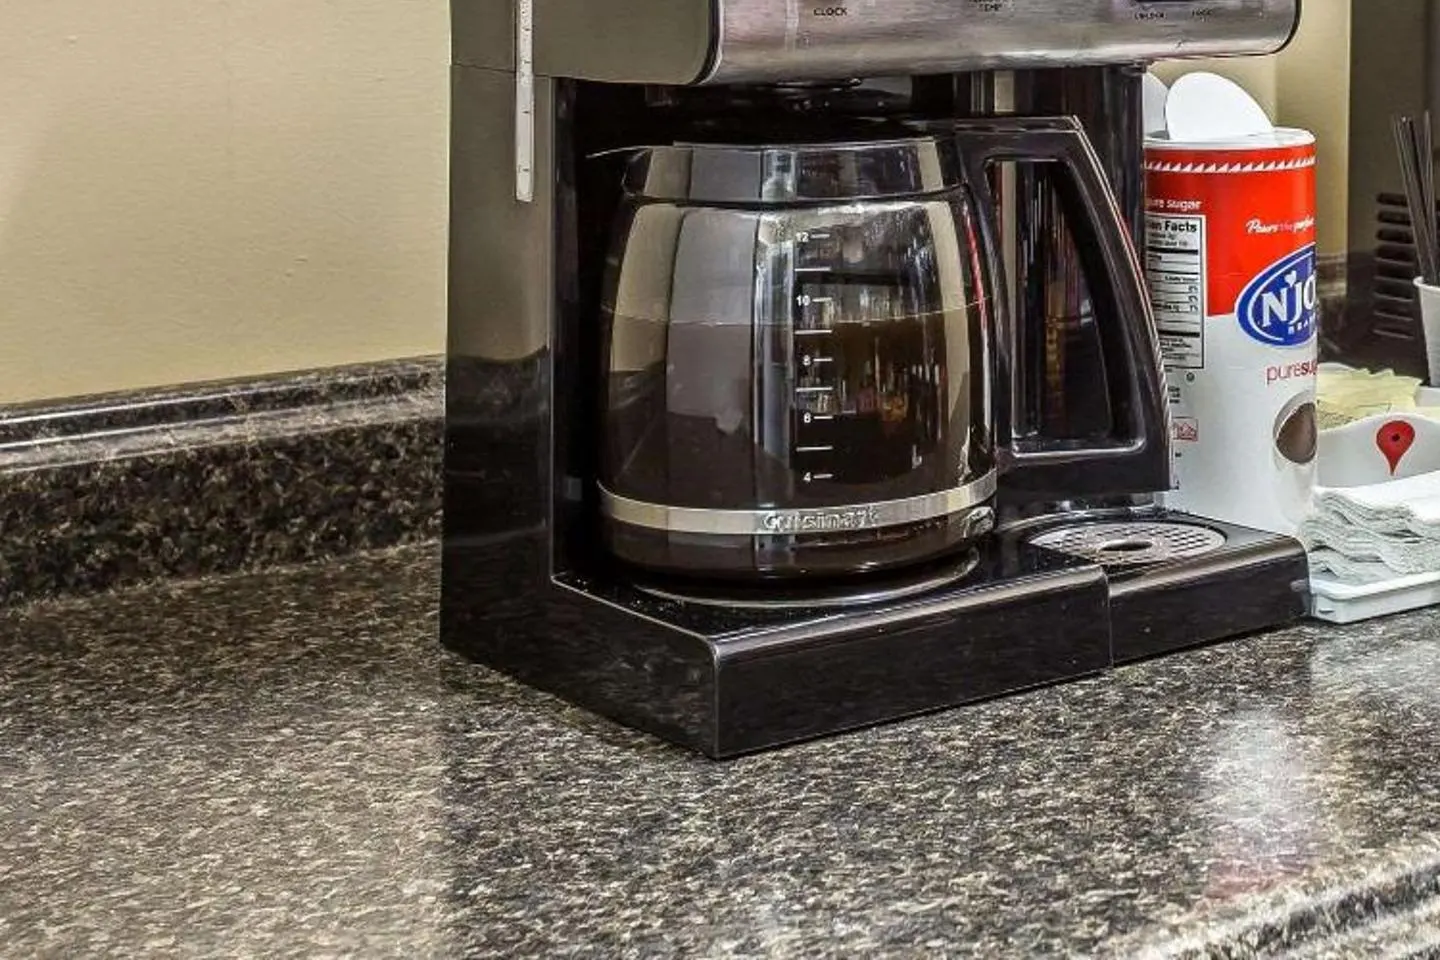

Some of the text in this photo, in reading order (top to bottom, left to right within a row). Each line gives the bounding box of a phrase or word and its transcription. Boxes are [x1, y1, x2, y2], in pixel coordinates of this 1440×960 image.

[813, 7, 848, 16] CLOCK
[1166, 200, 1202, 212] sugar
[1164, 220, 1198, 233] Facts
[796, 232, 809, 243] 12
[796, 294, 811, 307] 10
[803, 471, 812, 483] 4
[762, 507, 879, 532] Cuisinart
